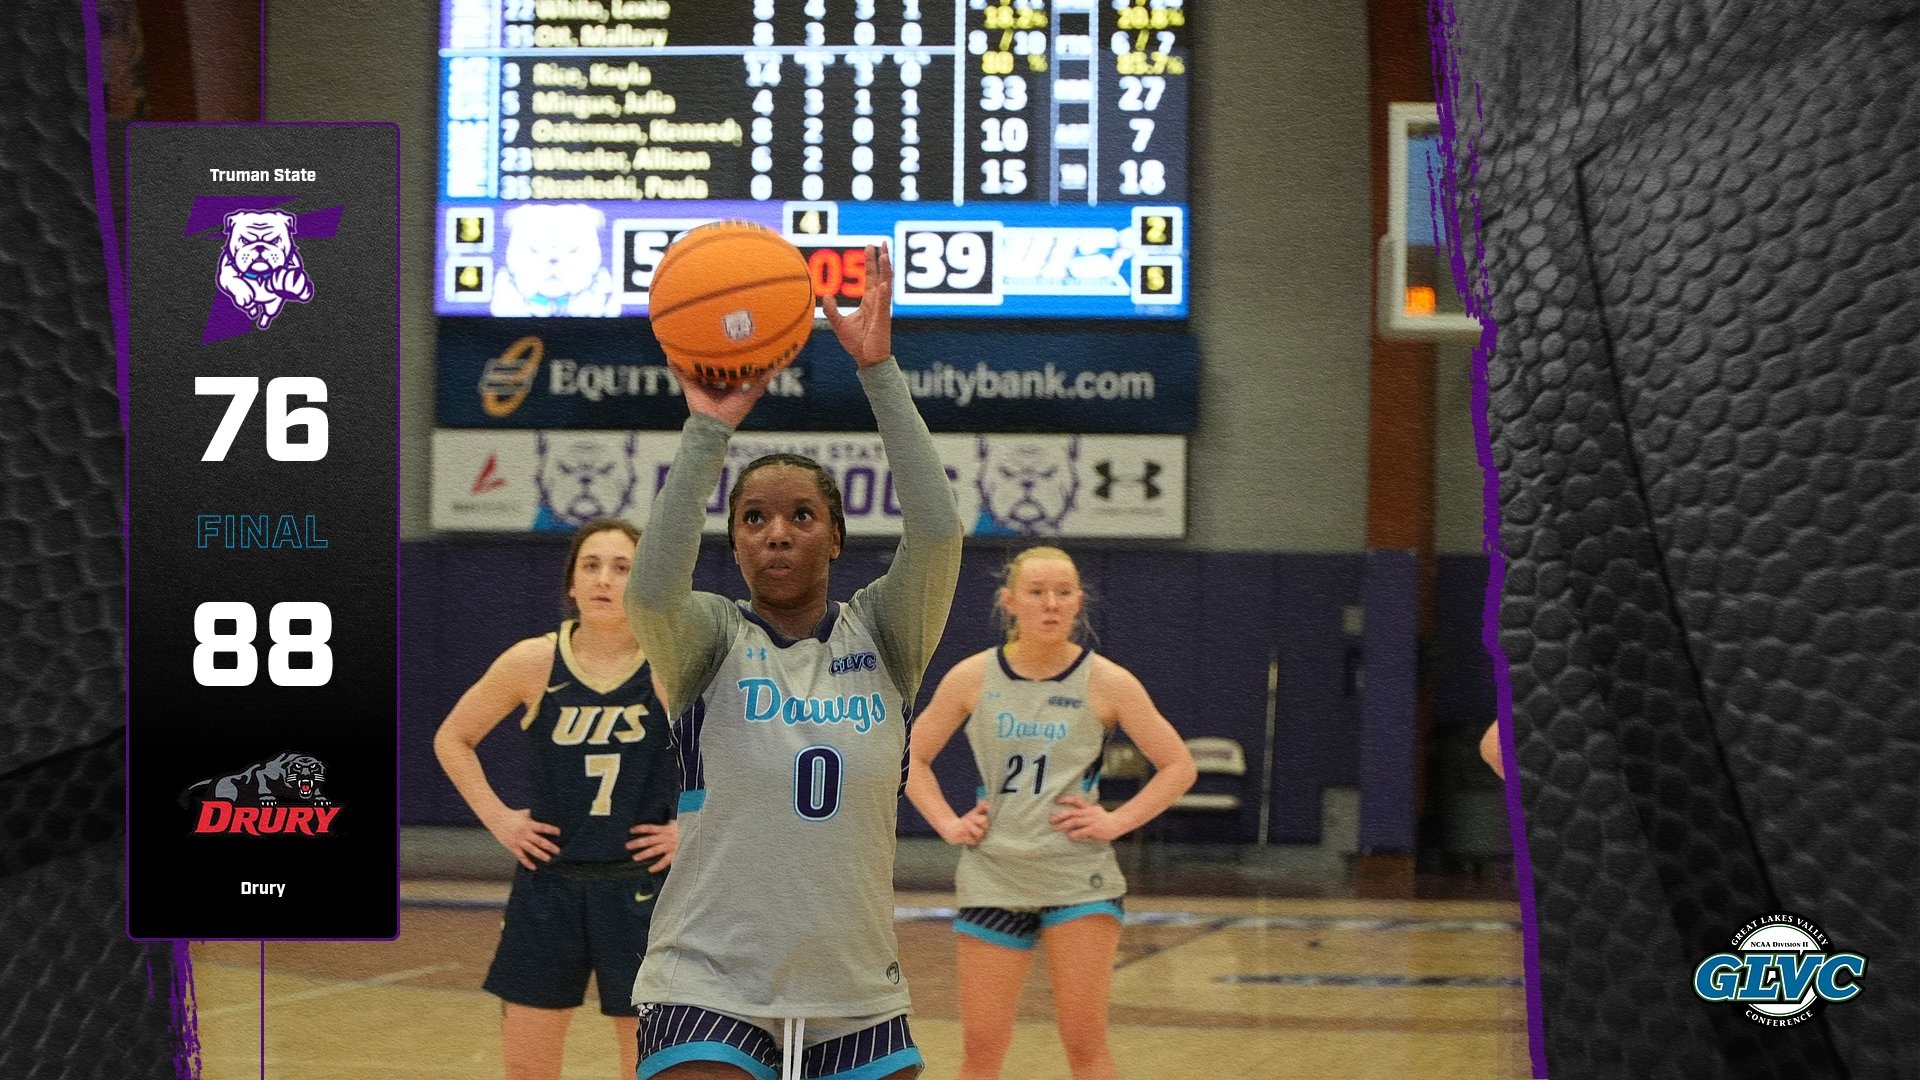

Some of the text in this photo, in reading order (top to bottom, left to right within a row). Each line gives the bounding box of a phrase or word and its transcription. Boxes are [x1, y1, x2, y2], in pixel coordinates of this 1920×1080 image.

[590, 61, 651, 91] Kayla
[979, 75, 1028, 111] 33
[1118, 75, 1166, 111] 27
[501, 118, 520, 143] 7
[803, 117, 823, 144] 2
[852, 117, 874, 144] 0
[901, 117, 920, 144] 1
[980, 117, 1029, 152] 10
[1128, 118, 1155, 153] 7
[803, 145, 823, 173] 2
[851, 145, 874, 172] 0
[900, 145, 920, 173] 2
[980, 159, 1028, 194] 15
[900, 174, 919, 201] 1
[1118, 159, 1166, 195] 18
[1145, 216, 1167, 244] 2
[905, 231, 987, 291] 39
[902, 361, 1157, 406] uitybank.com
[829, 651, 877, 676] GLVC
[736, 677, 887, 735] Dawgs
[551, 703, 650, 746] UIS
[996, 711, 1069, 744] Dawgs
[584, 752, 621, 816] 7
[794, 744, 843, 822] 0
[1000, 753, 1048, 795] 21
